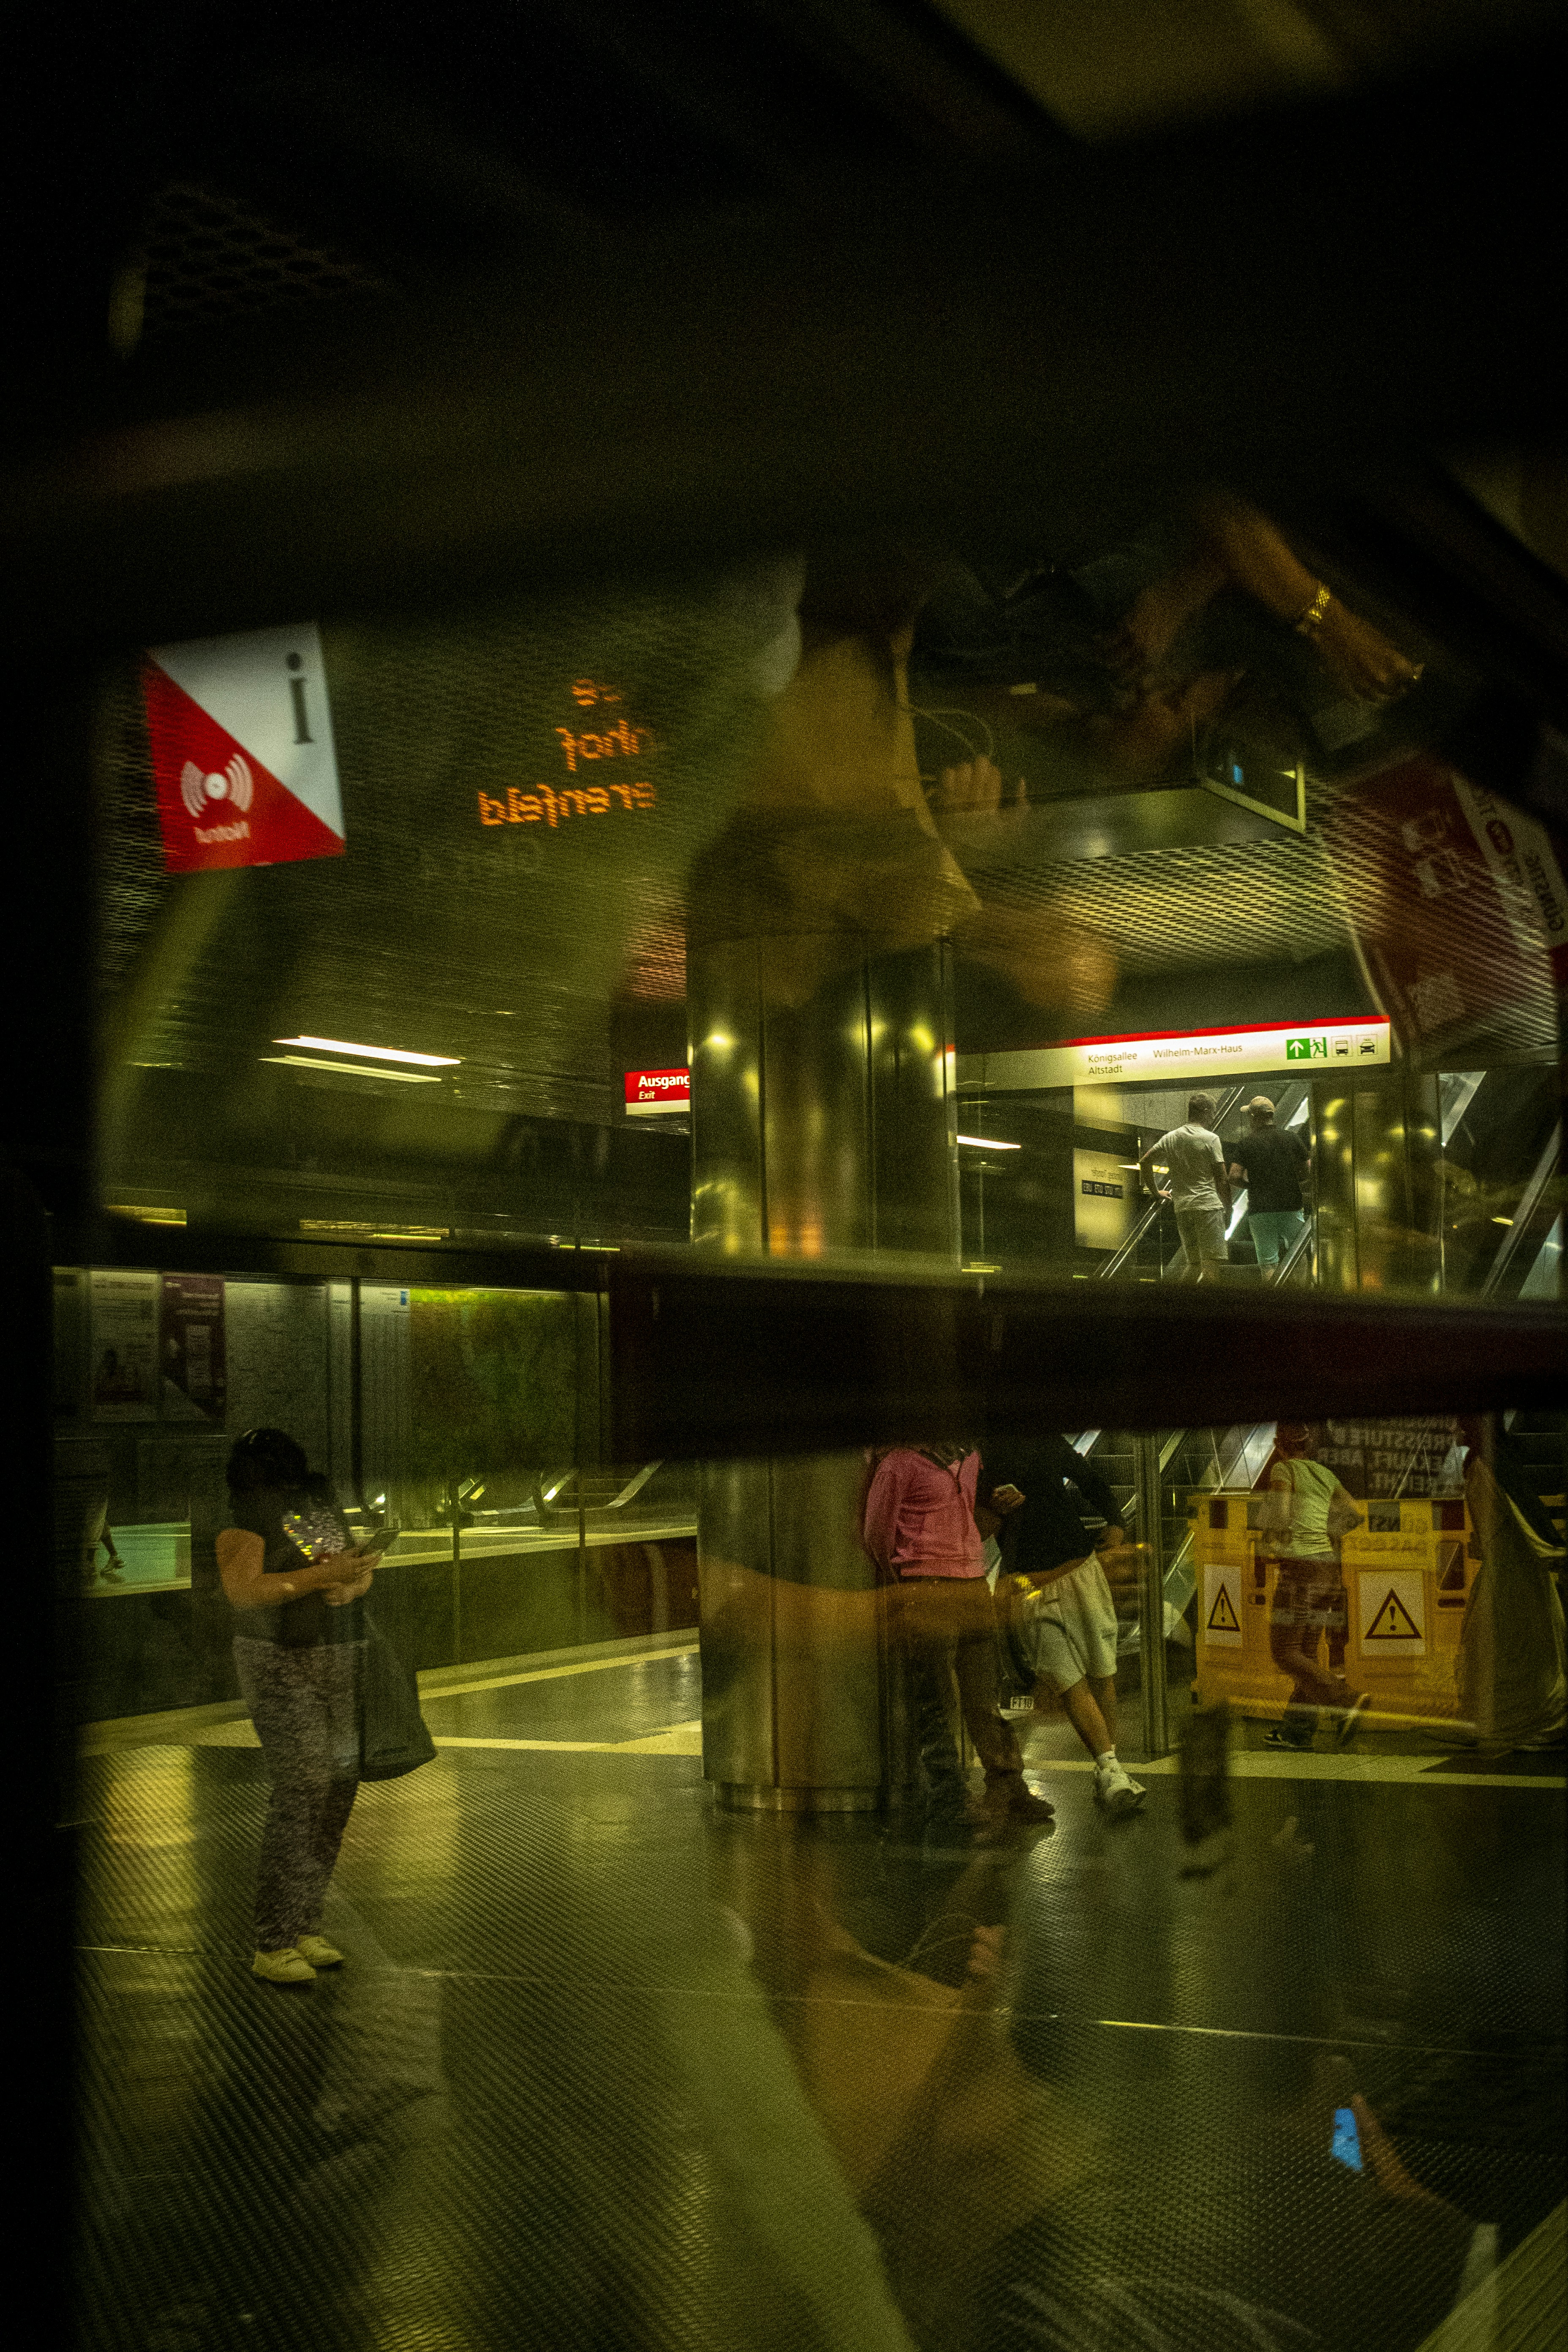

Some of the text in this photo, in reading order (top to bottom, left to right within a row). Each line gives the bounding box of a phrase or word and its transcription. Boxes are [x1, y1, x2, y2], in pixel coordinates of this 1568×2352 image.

[1088, 1045, 1242, 1063] Königsallee Wilhelm-Marx-Haus
[1089, 1064, 1122, 1075] Altstadt
[638, 1075, 690, 1089] Ausgang
[638, 1091, 656, 1100] Exit
